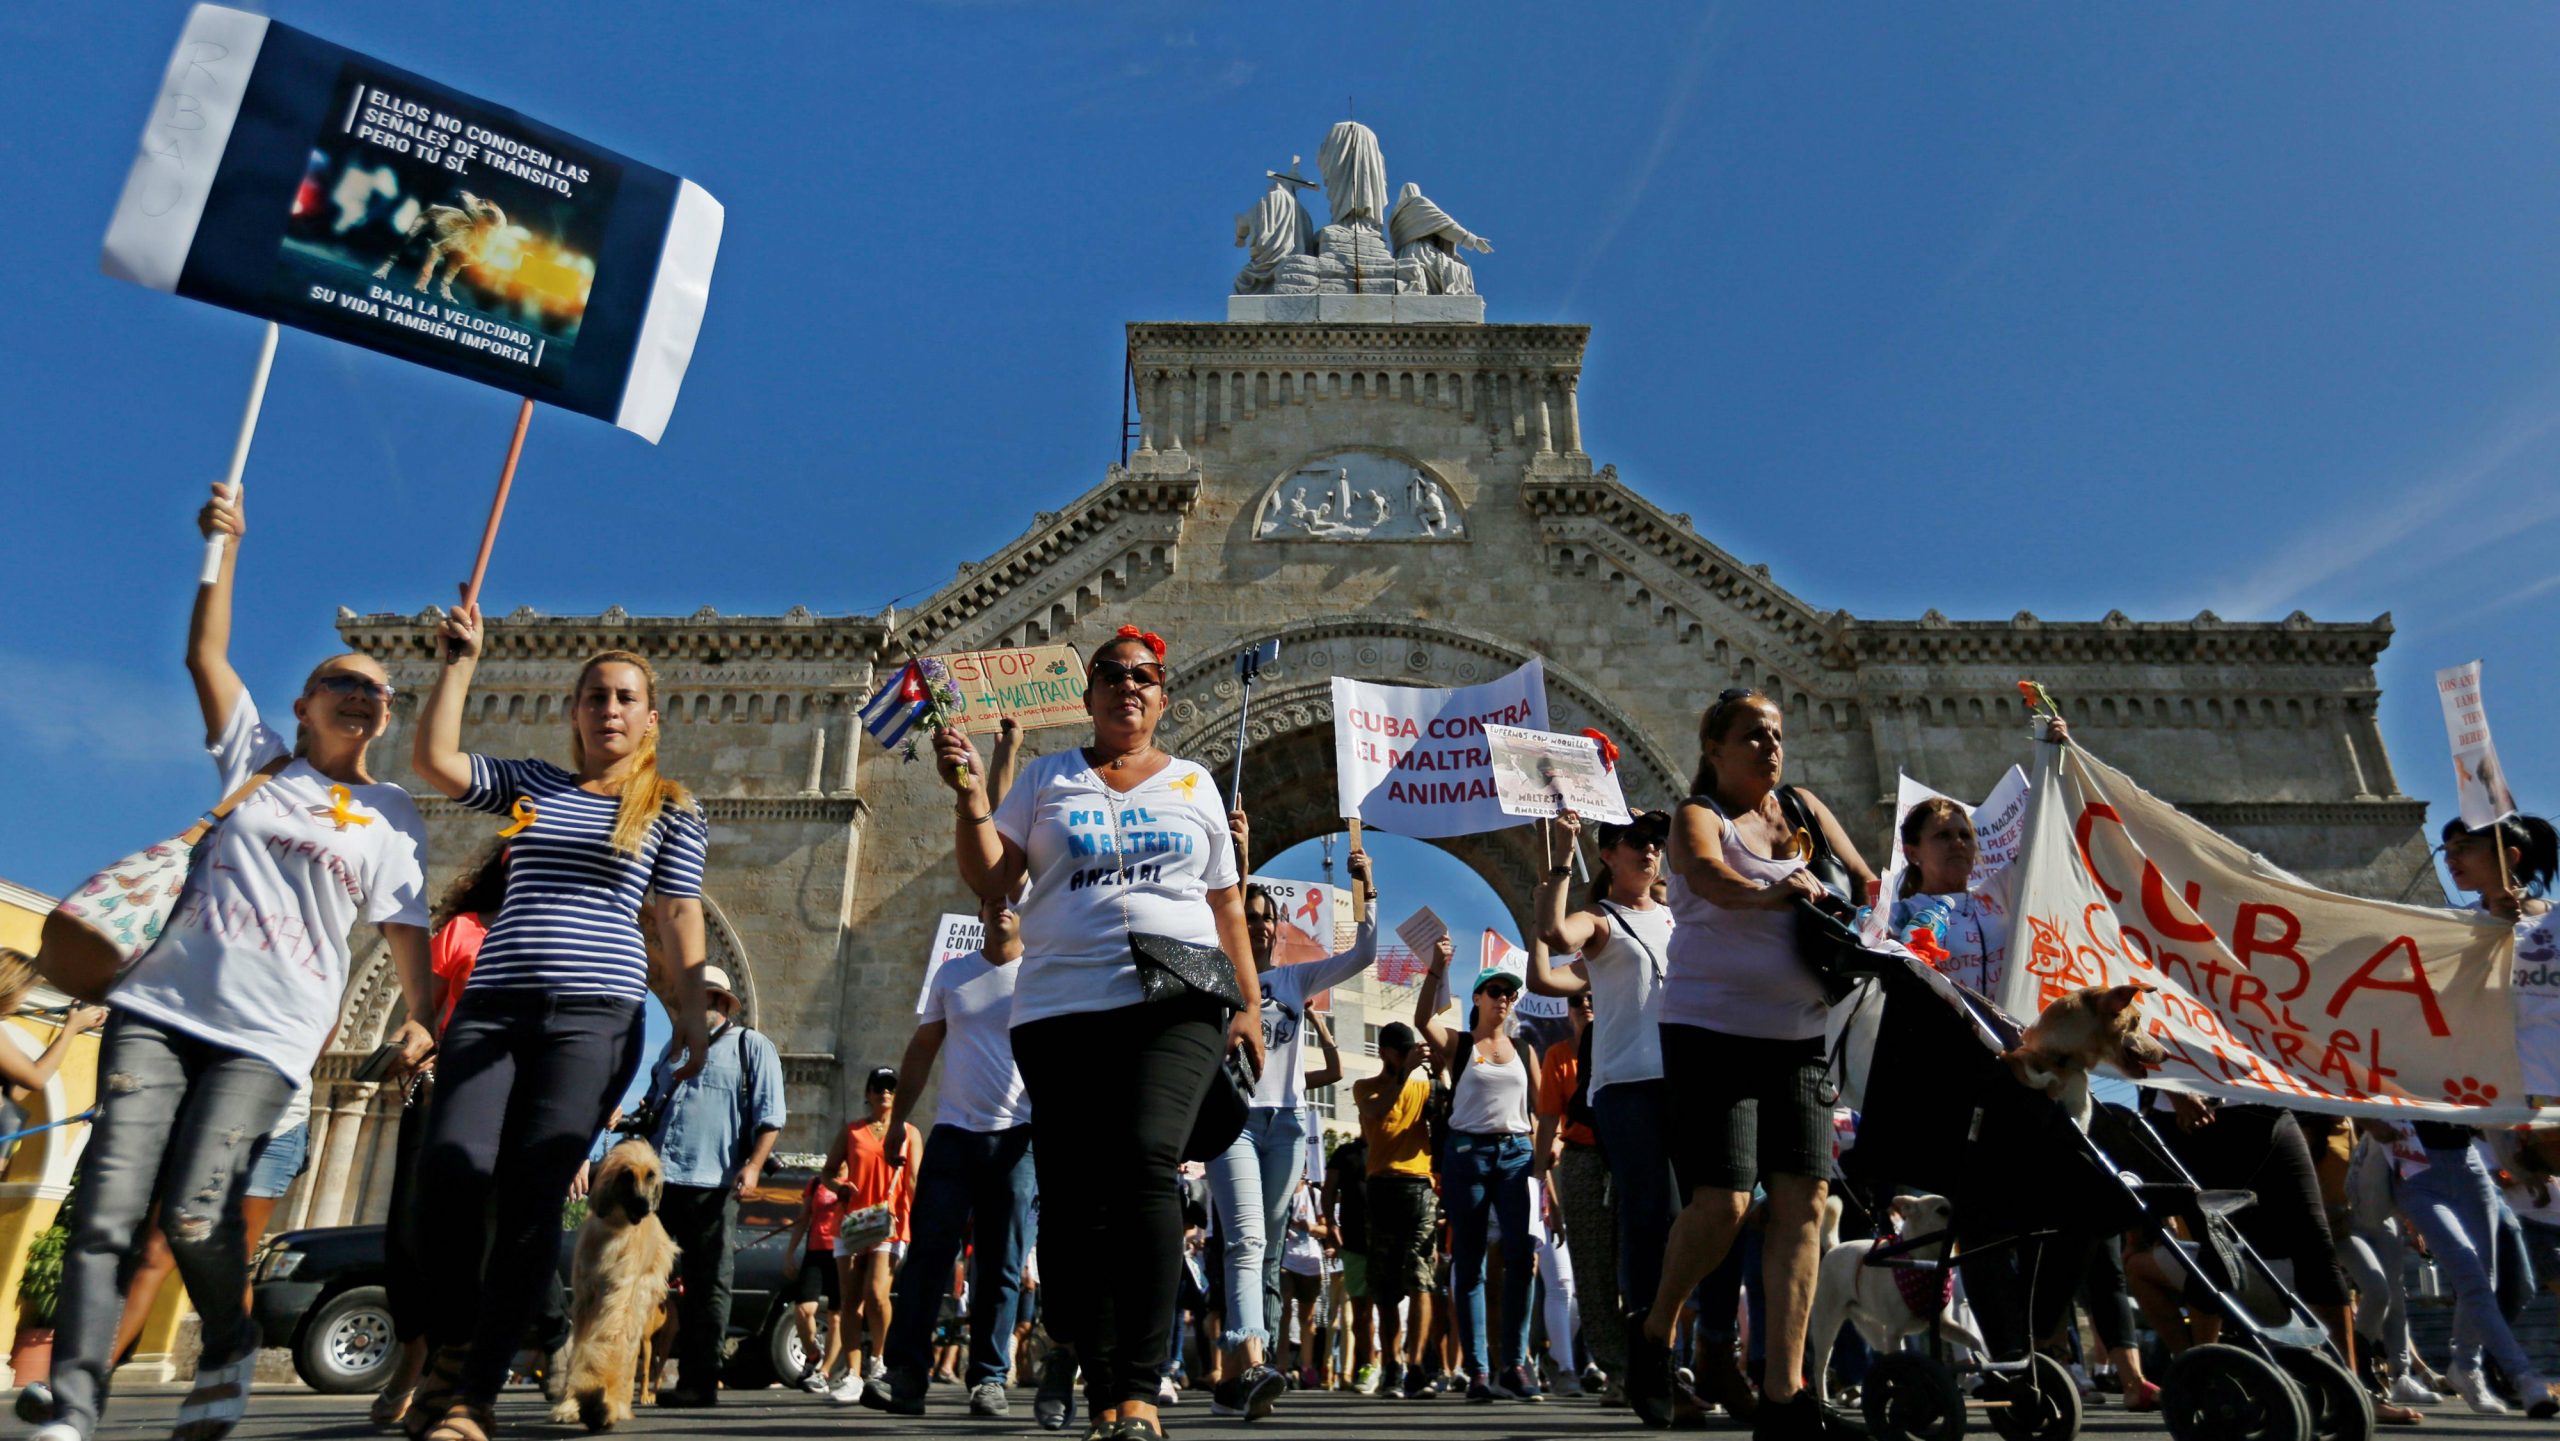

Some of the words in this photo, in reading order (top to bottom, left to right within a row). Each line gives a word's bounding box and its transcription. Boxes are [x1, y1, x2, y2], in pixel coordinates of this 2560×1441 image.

[358, 125, 411, 153] PERO
[416, 143, 442, 164] TÚ
[444, 155, 469, 176] SÍ.
[364, 108, 450, 149] SEÑALES
[454, 139, 480, 160] DE
[484, 149, 573, 198] TRÁNSITO,
[370, 90, 430, 122] ELLOS
[434, 113, 462, 134] NO
[466, 126, 553, 169] CONOCEN
[555, 160, 590, 184] LAS
[310, 286, 337, 303] SU
[340, 294, 379, 318] VIDA
[384, 308, 458, 341] TAMBIÉN
[459, 331, 529, 364] IMPORTA
[370, 286, 413, 310] BAJA
[417, 301, 439, 318] LA
[444, 308, 533, 350] VELOCIDAD,
[953, 653, 1036, 682] STOP
[1349, 708, 1420, 739] CUBA
[1428, 698, 1532, 740] CONTRA
[1356, 739, 1381, 764] EL
[1120, 808, 1157, 827] AL
[1987, 827, 2017, 850] PUEDE
[1068, 831, 1193, 859] MALTRATO
[1070, 864, 1162, 891] ANIMAL
[2075, 801, 2451, 1036] CUBA
